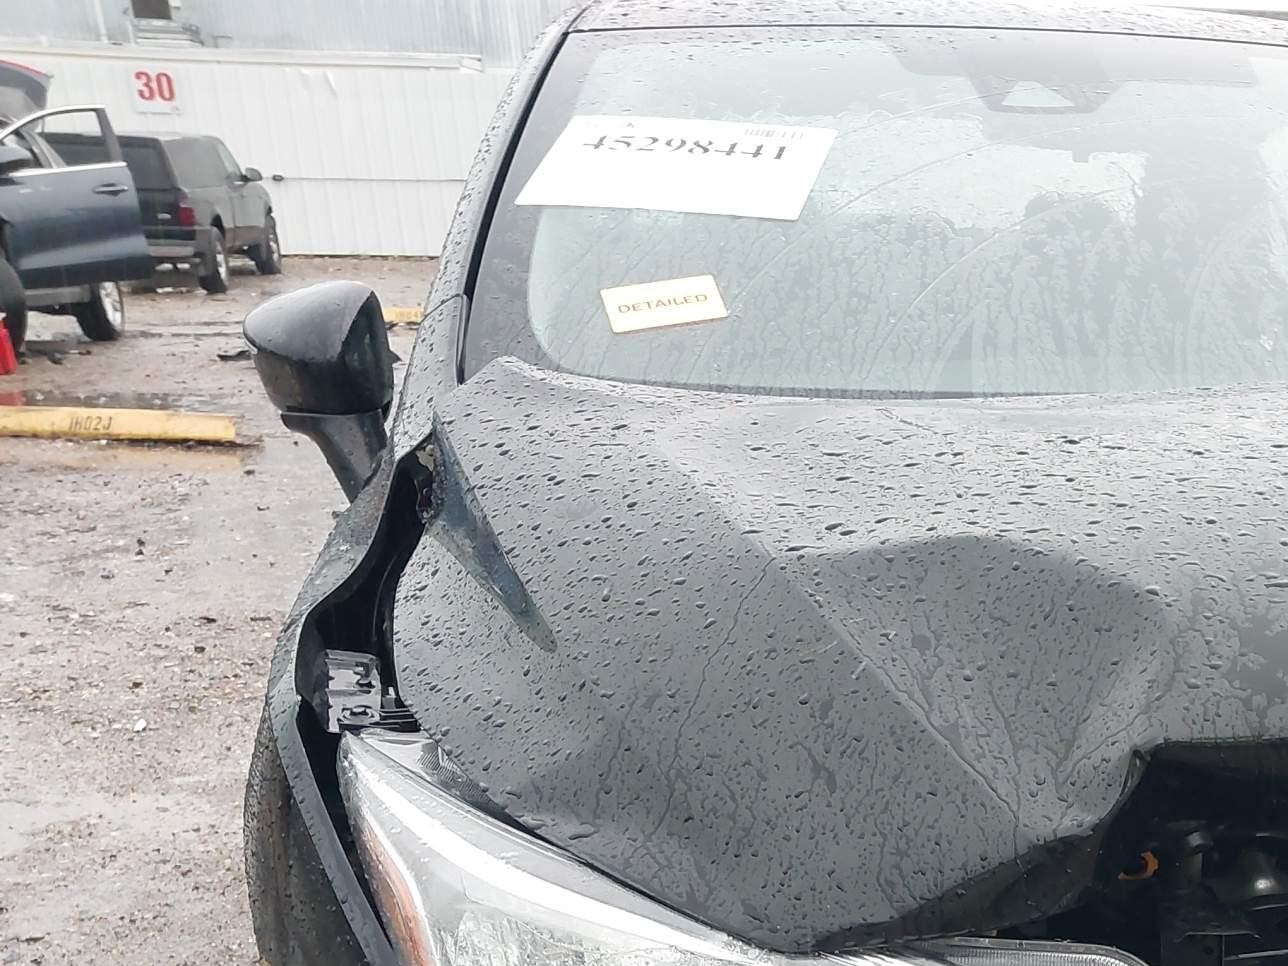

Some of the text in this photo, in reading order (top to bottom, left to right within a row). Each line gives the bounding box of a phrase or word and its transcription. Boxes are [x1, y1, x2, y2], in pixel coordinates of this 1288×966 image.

[134, 71, 175, 101] 30
[583, 135, 787, 160] 45298441
[617, 294, 708, 313] DETAILED
